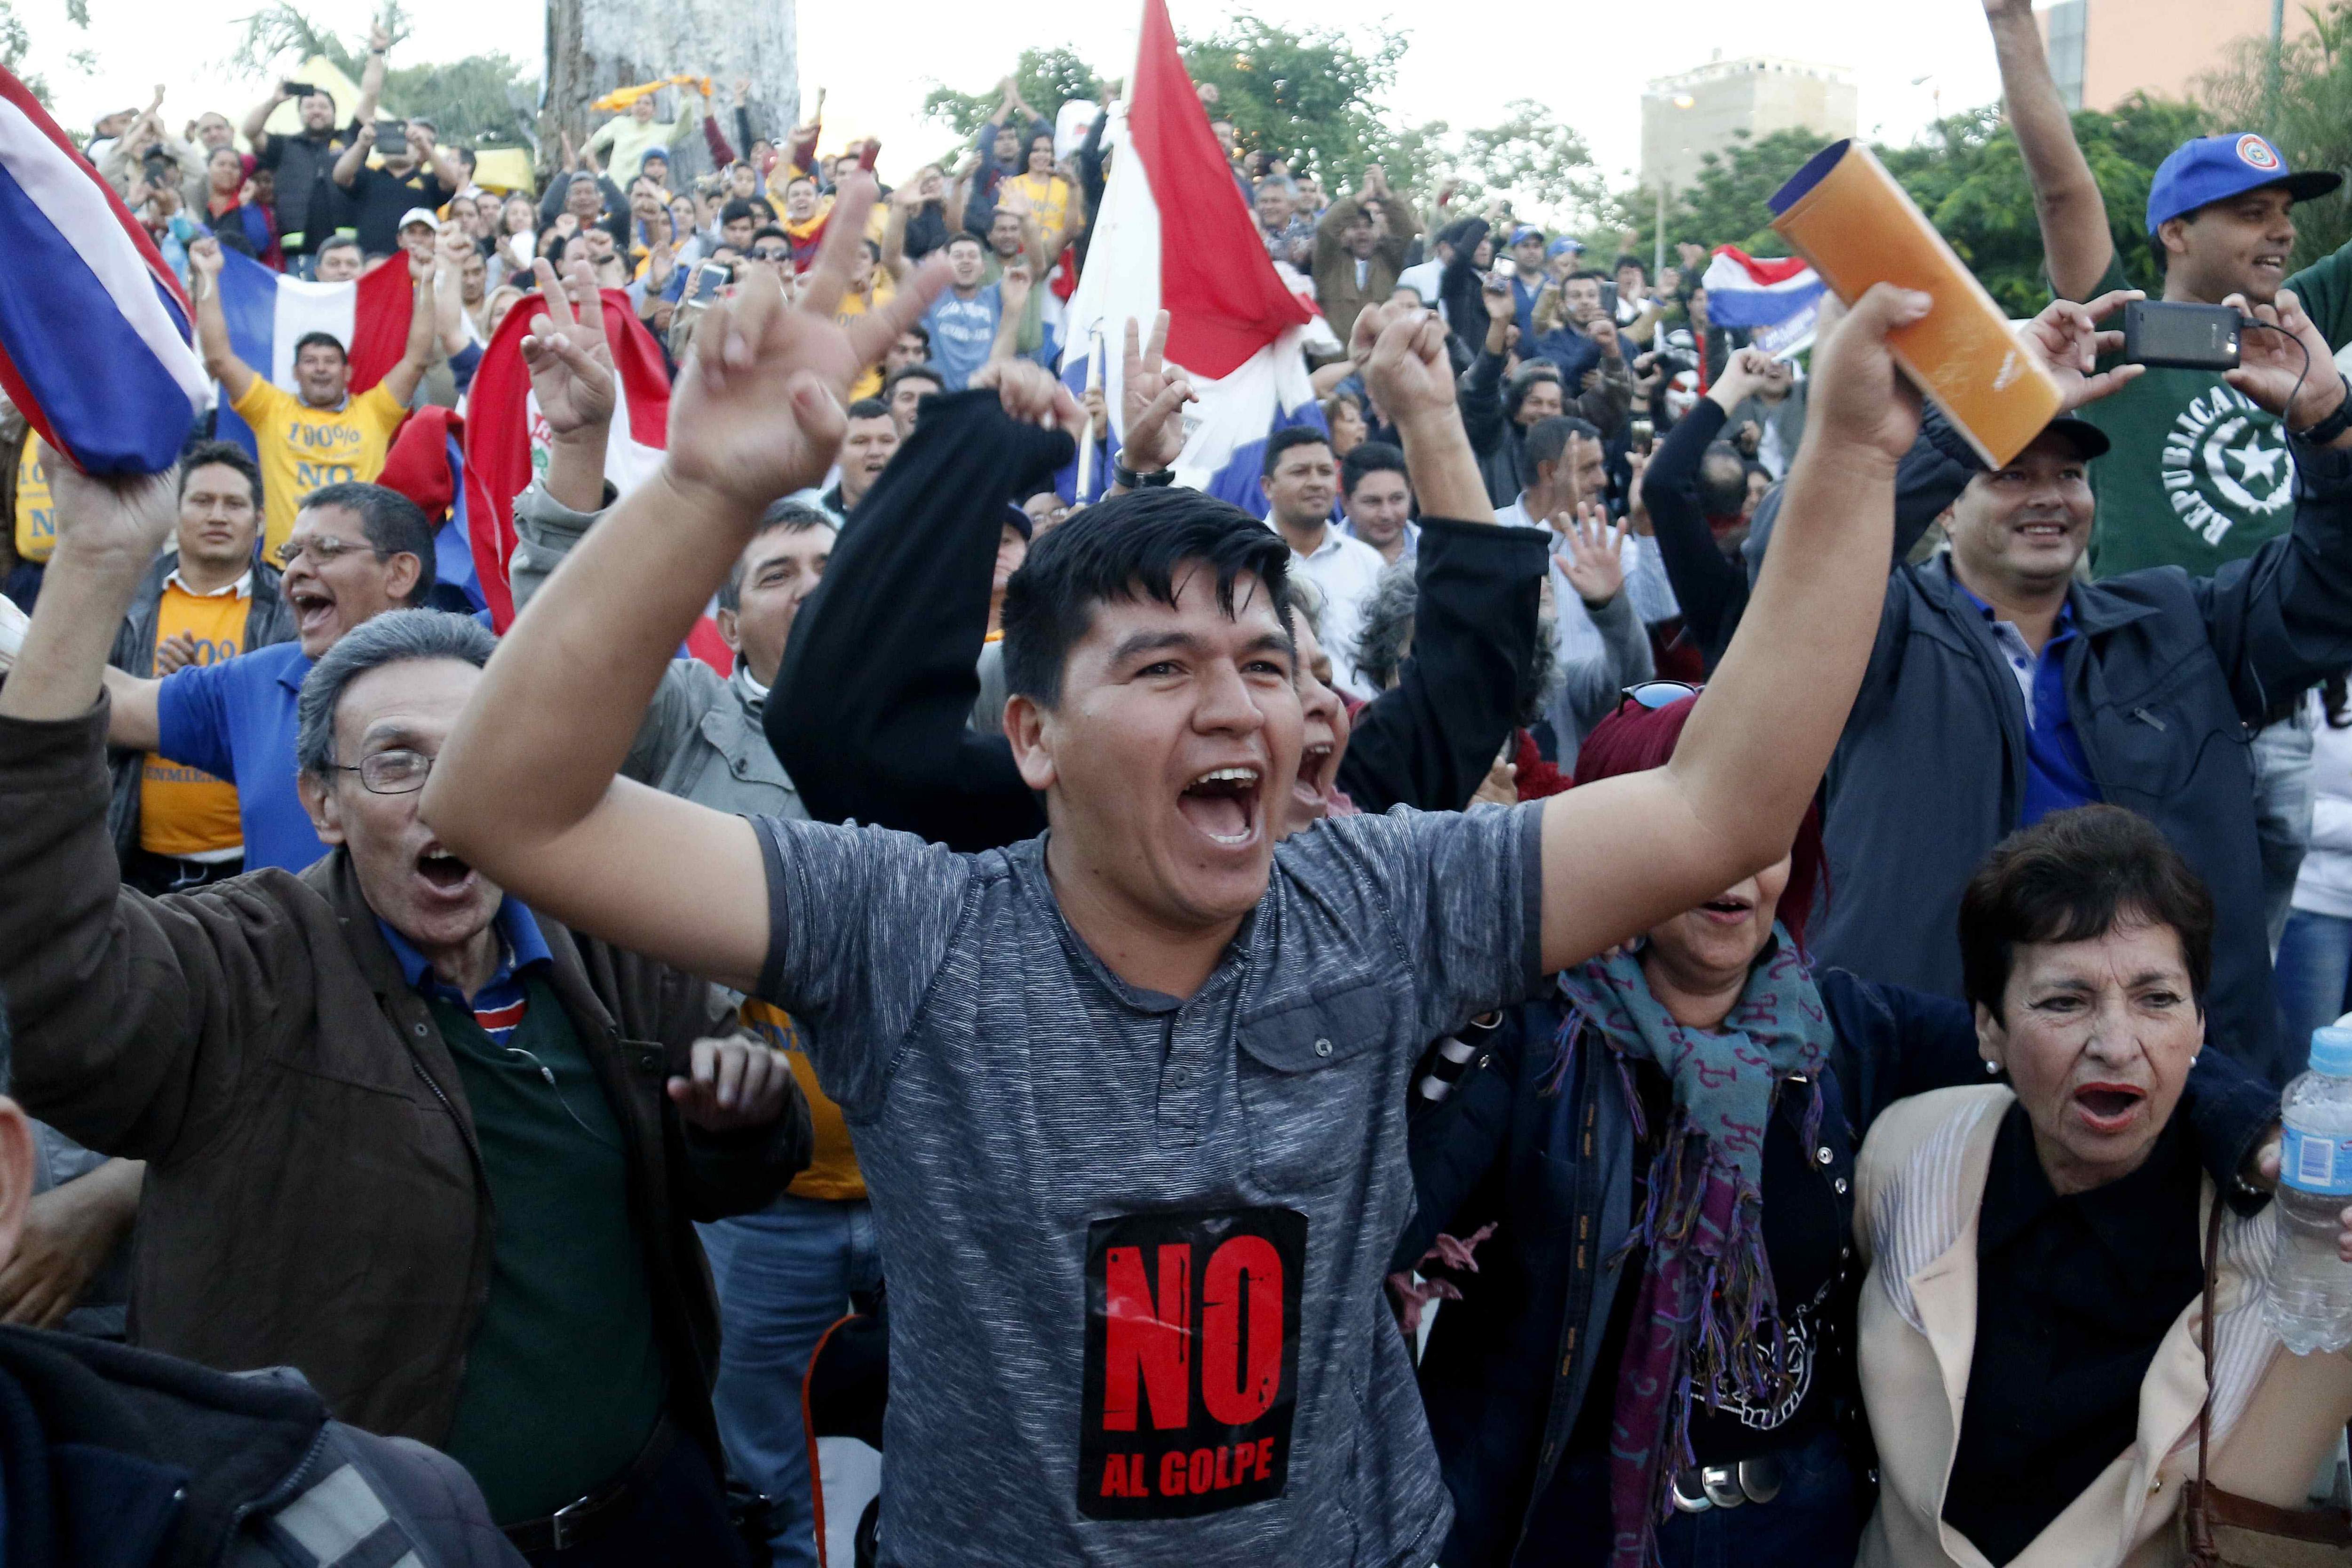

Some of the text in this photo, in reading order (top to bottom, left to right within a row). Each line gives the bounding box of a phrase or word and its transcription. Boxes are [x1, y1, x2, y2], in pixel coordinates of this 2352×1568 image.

[288, 422, 361, 448] 100%
[296, 461, 354, 486] NO
[1103, 1235, 1283, 1431] NO
[1100, 1437, 1274, 1497] AL GOLPE
